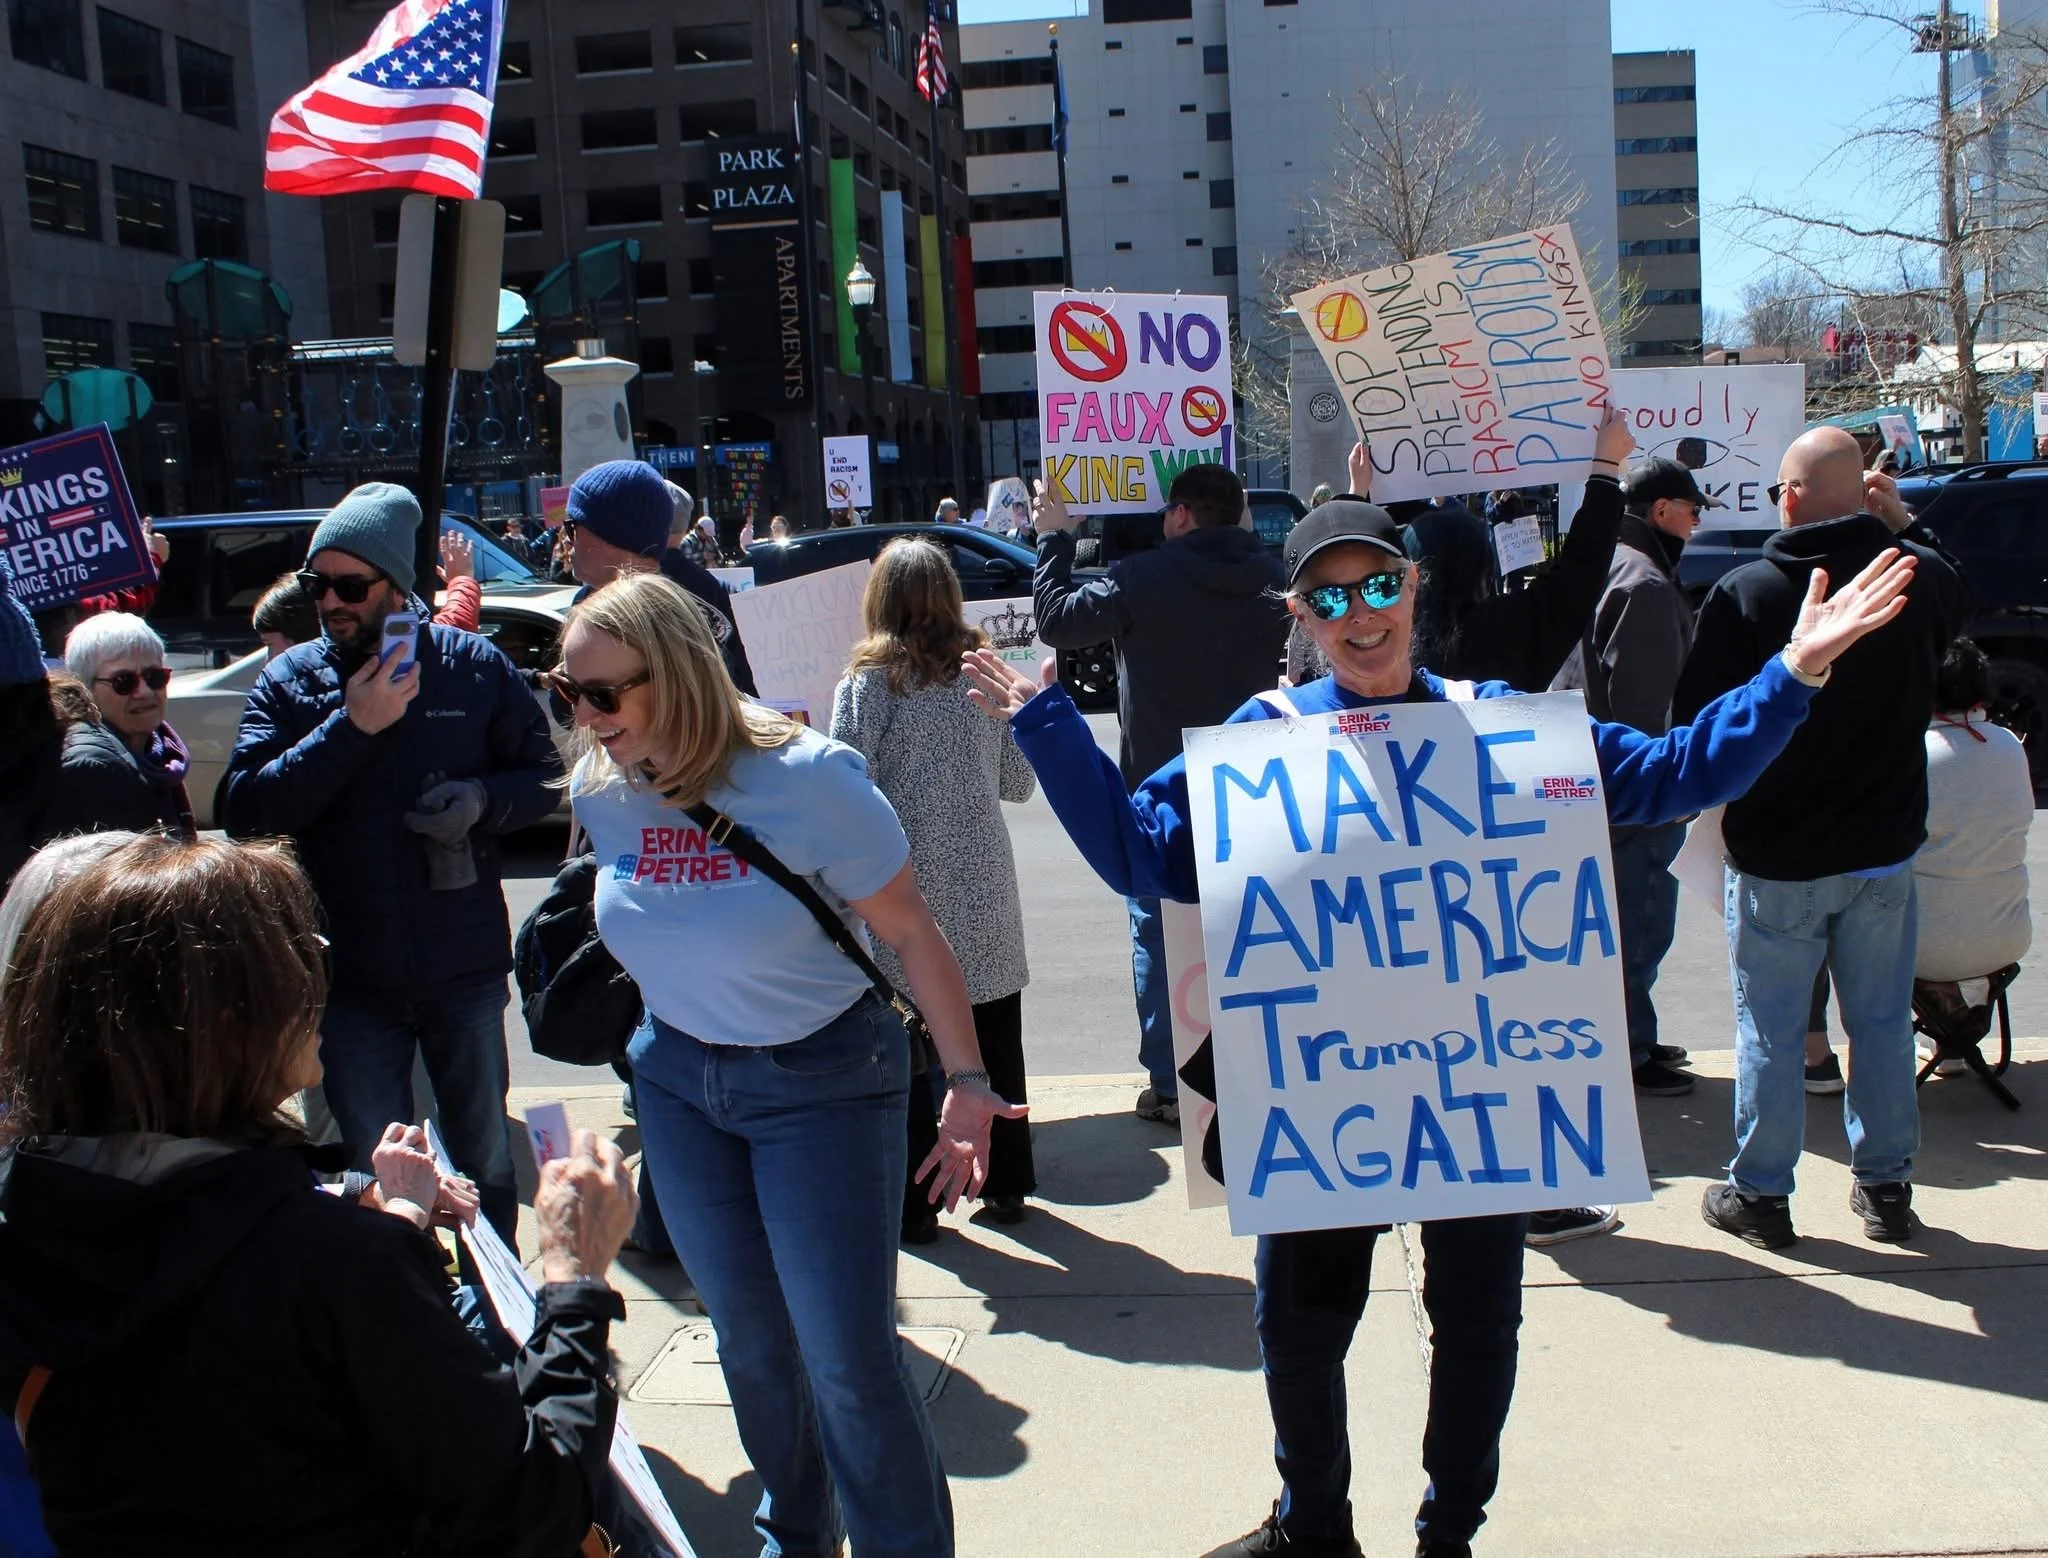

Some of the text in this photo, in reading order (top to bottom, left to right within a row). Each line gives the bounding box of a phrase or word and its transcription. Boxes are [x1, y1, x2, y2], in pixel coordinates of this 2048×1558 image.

[719, 148, 784, 172] PARK
[712, 184, 795, 209] PLAZA
[775, 236, 805, 400] APARTMENTS
[1424, 281, 1470, 318] IS
[1138, 312, 1222, 372] NO
[1538, 246, 1609, 408] NO KINGS
[1362, 264, 1467, 477] PRETENDING
[1047, 392, 1174, 446] FAUX
[1335, 350, 1421, 475] STOP
[830, 465, 859, 473] RACISM
[1046, 454, 1147, 504] KING
[0, 467, 110, 522] KINGS
[9, 520, 128, 577] ERICA
[16, 518, 42, 540] IN
[52, 563, 89, 587] 1776
[1338, 713, 1370, 725] ERIN
[1339, 721, 1391, 734] PETREY
[1212, 729, 1546, 862] MAKE
[1543, 777, 1575, 788] ERIN
[1544, 787, 1596, 799] PETREY
[640, 827, 709, 855] ERIN
[633, 853, 750, 884] PETREY
[1224, 856, 1617, 983] AMERICA
[1219, 984, 1603, 1111] Trumpless
[1248, 1085, 1606, 1198] AGAIN
